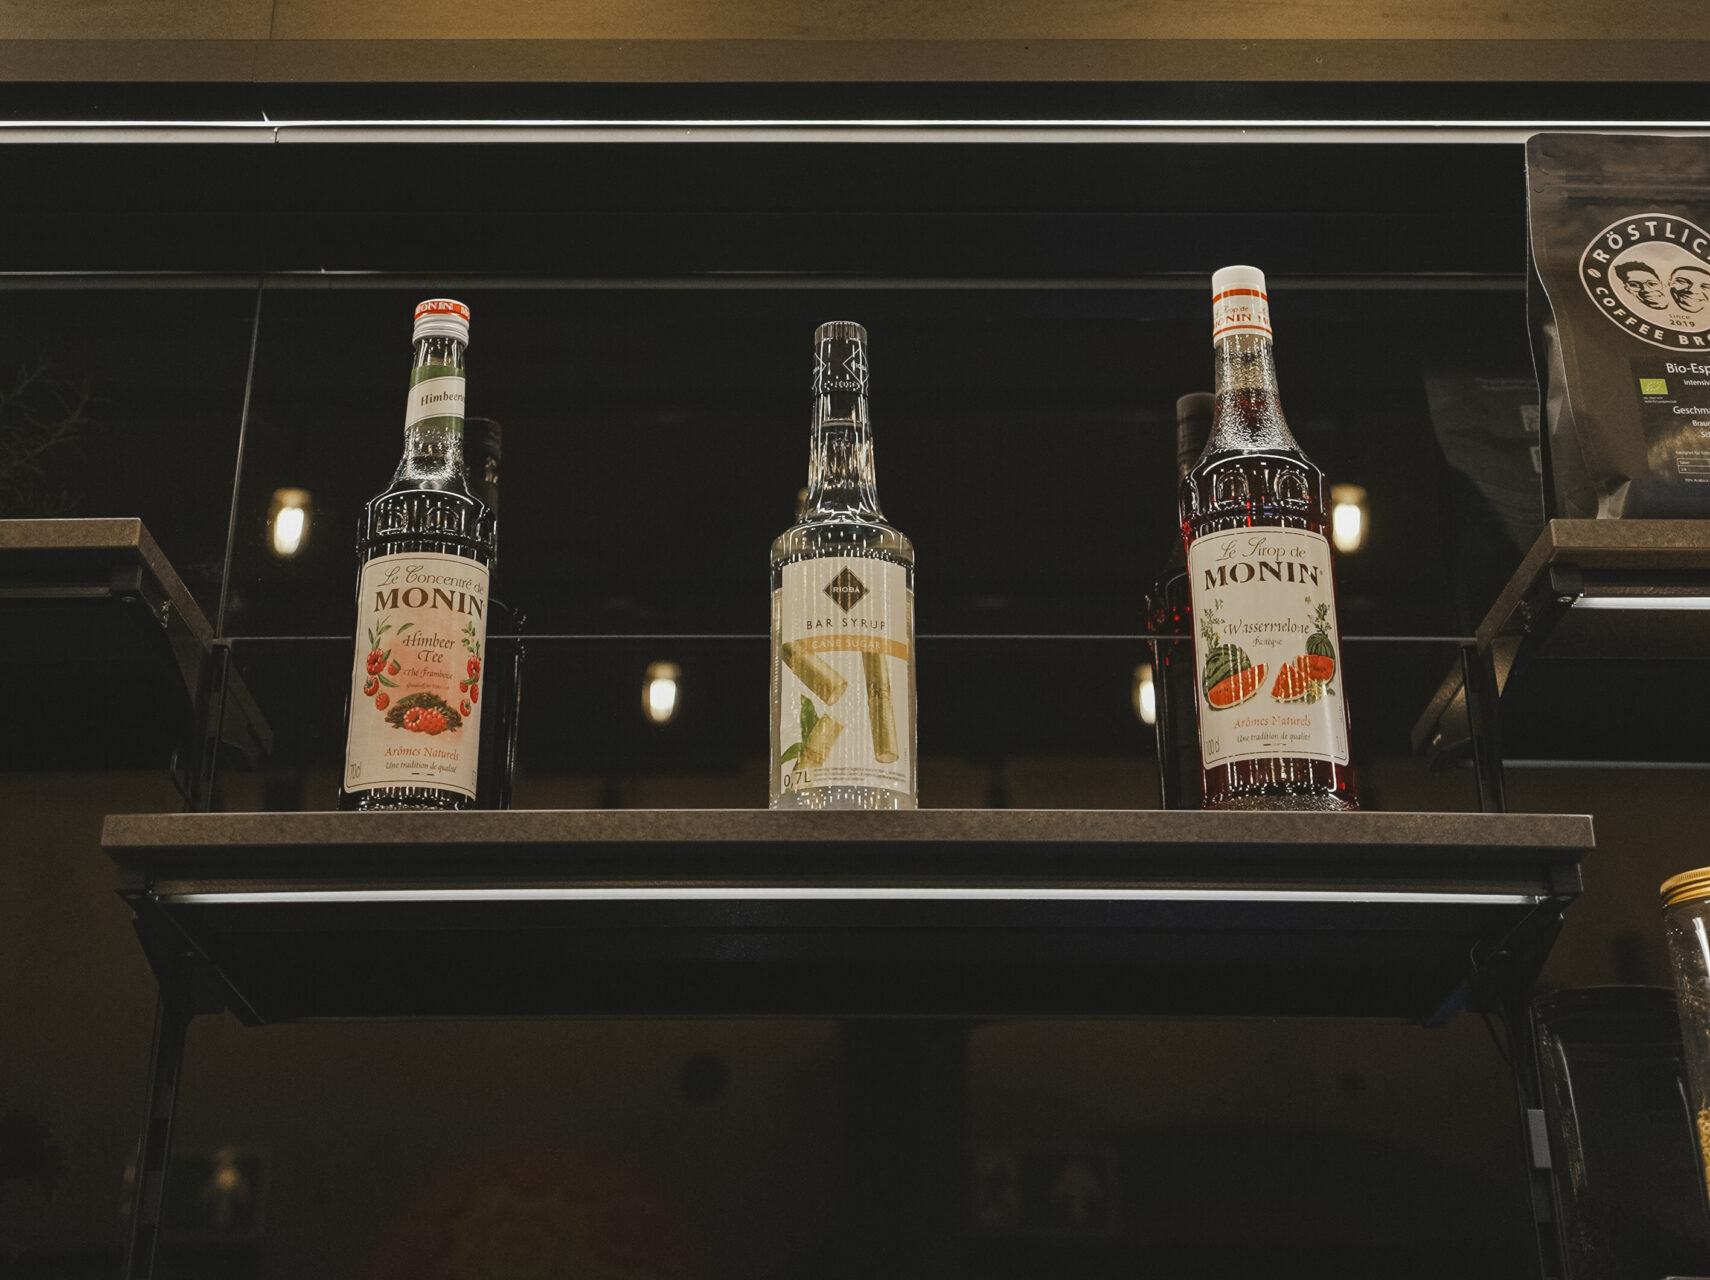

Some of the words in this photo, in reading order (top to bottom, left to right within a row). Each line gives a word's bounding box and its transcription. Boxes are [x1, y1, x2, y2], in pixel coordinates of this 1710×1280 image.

[1592, 221, 1710, 263] RÖSTLIC
[1596, 287, 1664, 340] COFFEE
[1670, 319, 1695, 328] 2019
[1216, 540, 1238, 561] Le
[1242, 536, 1286, 561] Sirop
[1290, 547, 1306, 558] de
[377, 565, 401, 587] Le
[405, 565, 472, 590] Concentré
[474, 583, 484, 594] de
[1204, 561, 1319, 591] MONIN
[833, 585, 860, 593] RIOBA
[374, 587, 483, 620] MONIN
[806, 618, 832, 630] BAR
[842, 618, 886, 630] SYRUP
[402, 630, 456, 649] Himbeer
[811, 639, 840, 649] CANE
[417, 650, 443, 663] Tee
[384, 746, 421, 757] Arômes
[424, 747, 459, 761] Naturels
[401, 760, 429, 770] tradition
[430, 761, 438, 770] de
